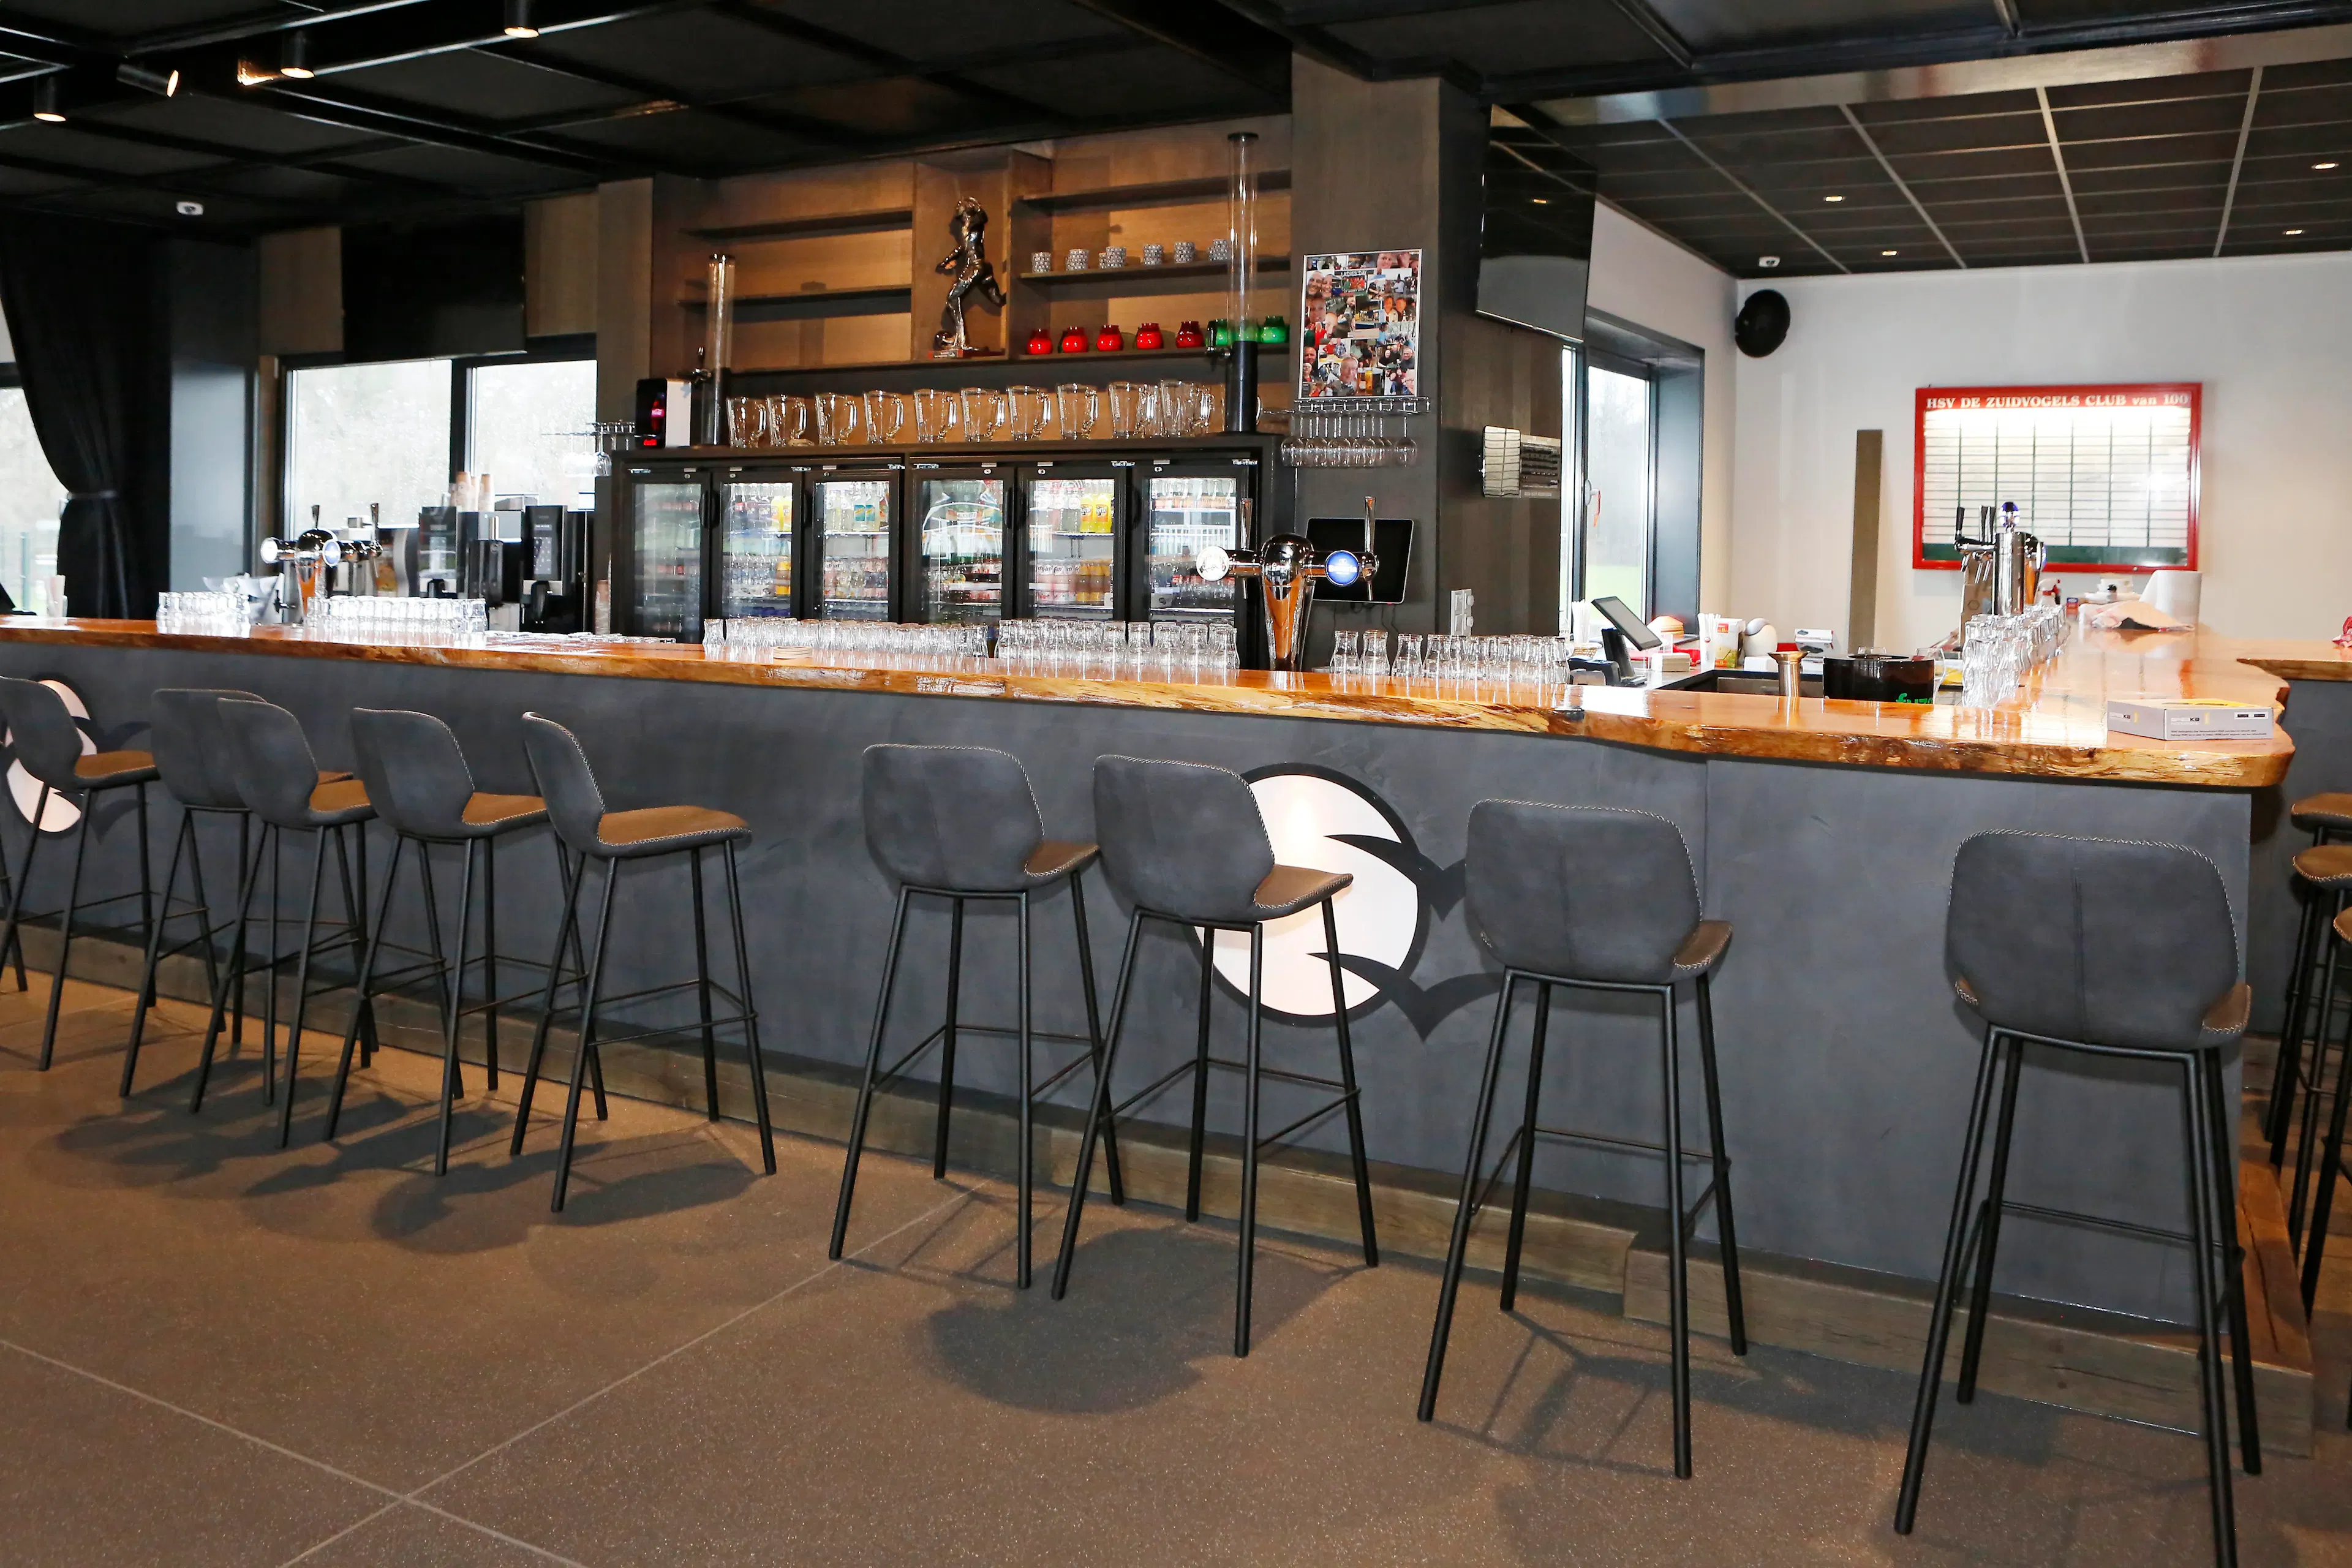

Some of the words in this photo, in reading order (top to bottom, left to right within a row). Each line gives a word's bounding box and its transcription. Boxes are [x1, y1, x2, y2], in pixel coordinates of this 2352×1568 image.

[1926, 398, 1956, 409] HSV
[1960, 396, 1981, 408] DE
[1985, 395, 2081, 409] ZUIDVOGELS
[2084, 394, 2127, 407] CLUB
[2132, 396, 2157, 405] van
[2163, 393, 2190, 405] 100
